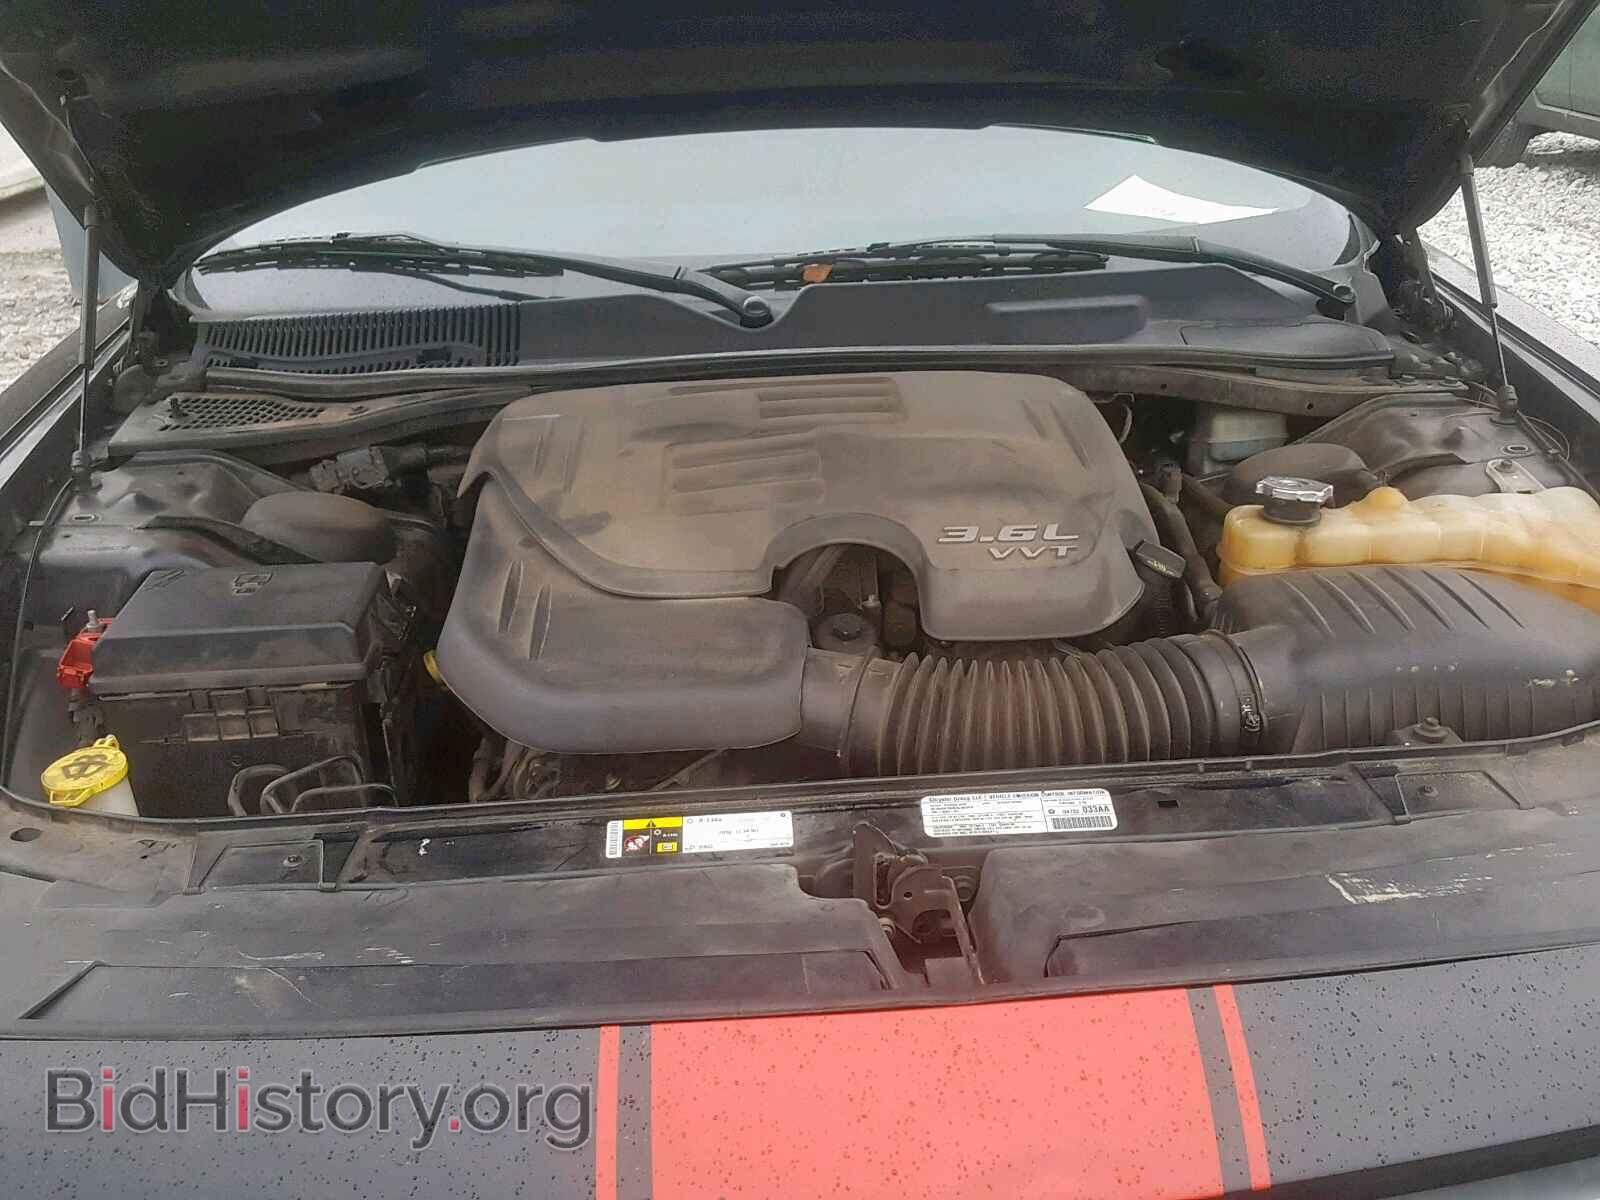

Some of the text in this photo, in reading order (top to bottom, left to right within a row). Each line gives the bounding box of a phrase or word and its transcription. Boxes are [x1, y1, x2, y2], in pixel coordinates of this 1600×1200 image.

[938, 523, 1079, 543] 3.6L
[989, 545, 1078, 559] VVT
[1082, 805, 1110, 814] 033AA
